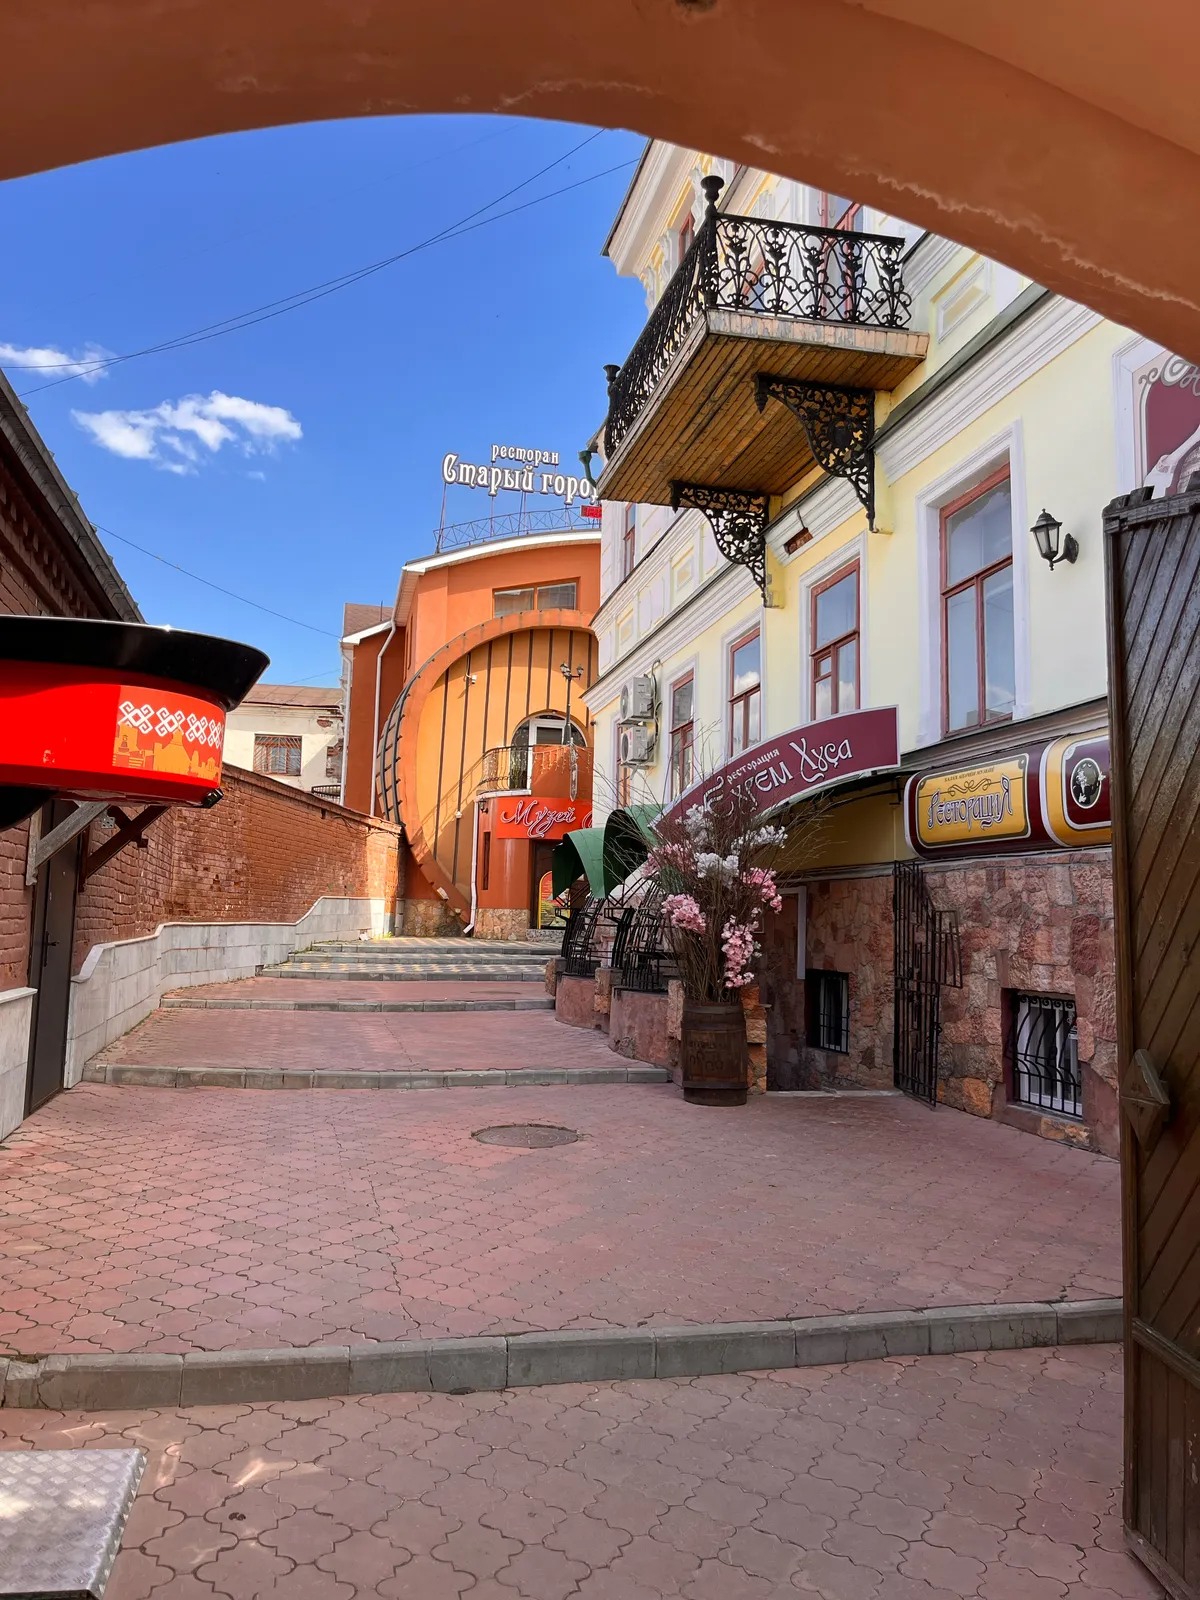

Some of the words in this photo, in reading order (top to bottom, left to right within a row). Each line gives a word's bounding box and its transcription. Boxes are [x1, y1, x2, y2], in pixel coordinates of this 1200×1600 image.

[491, 443, 560, 467] ресторан
[442, 452, 535, 497] Старый
[726, 748, 780, 785] ресторация
[500, 800, 577, 838] Музей
